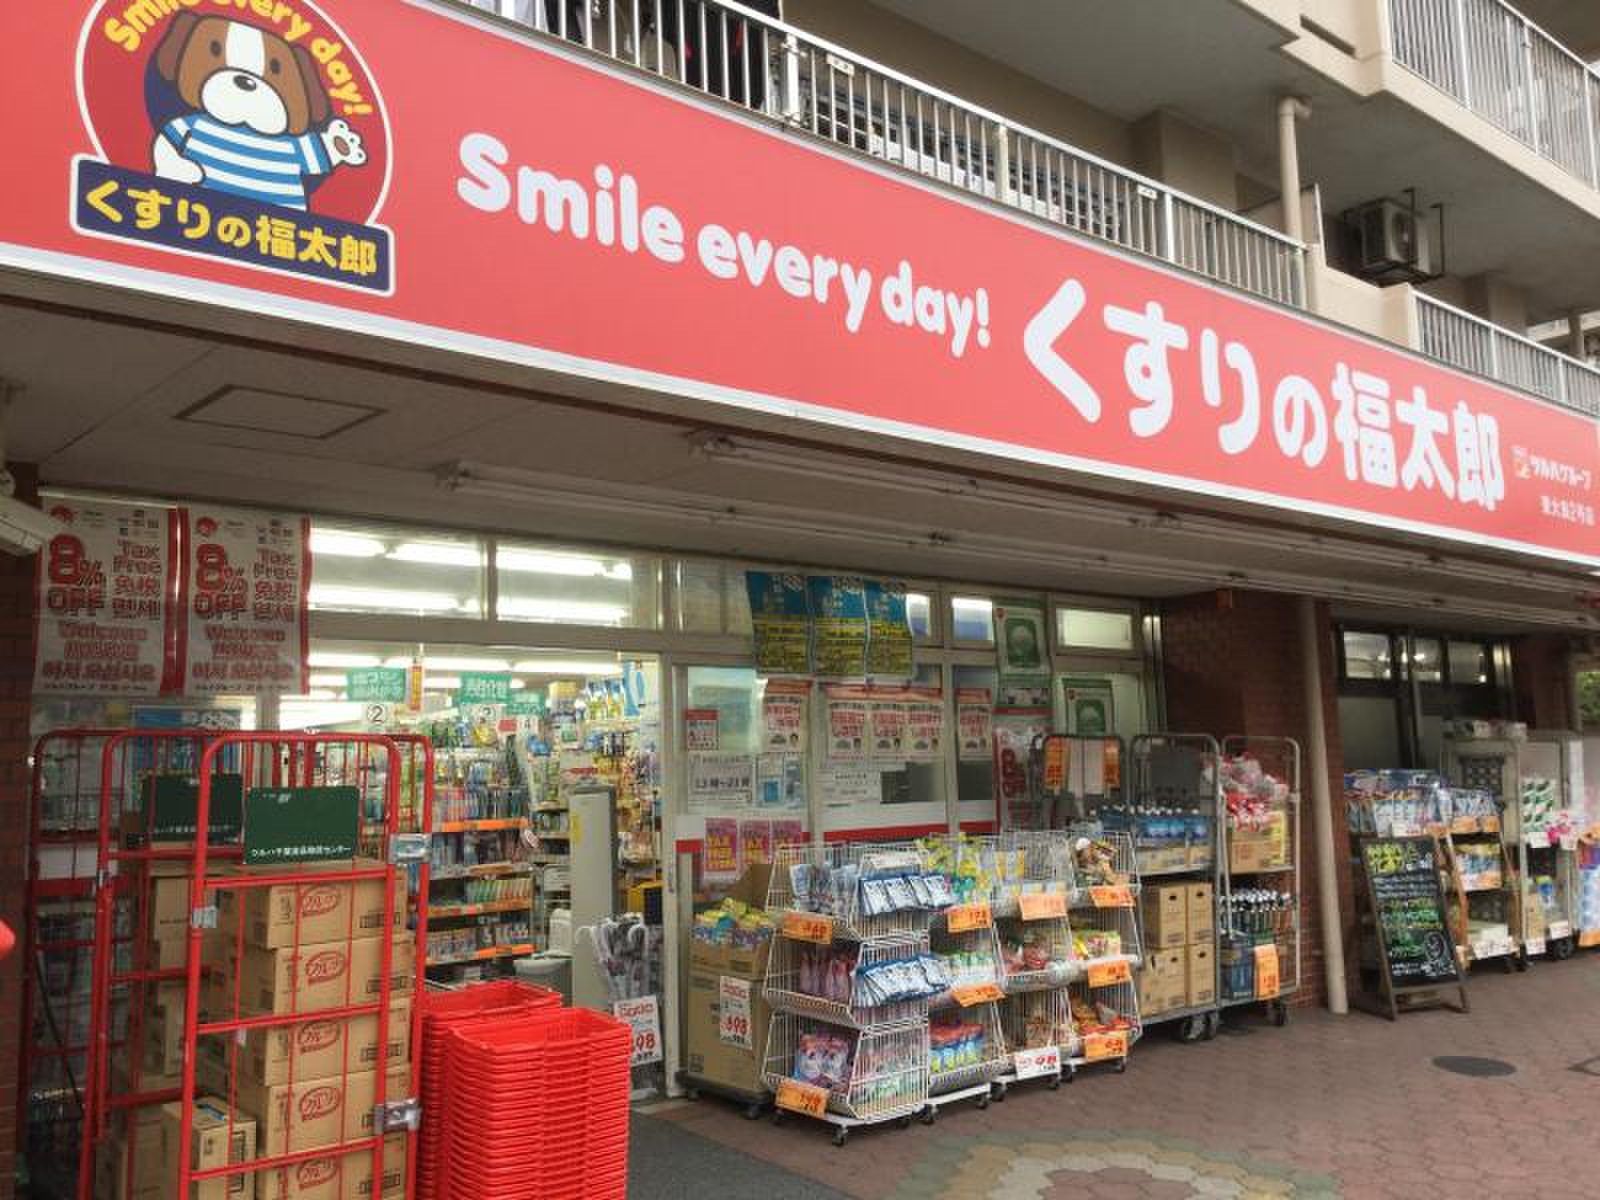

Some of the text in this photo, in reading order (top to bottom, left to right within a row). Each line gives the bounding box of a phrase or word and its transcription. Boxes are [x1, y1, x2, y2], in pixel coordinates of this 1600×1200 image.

[310, 37, 374, 115] day!
[86, 180, 378, 275] くすりの福太郎
[456, 132, 992, 358] Smile every day!
[1022, 277, 1506, 512] くすりの福太郎
